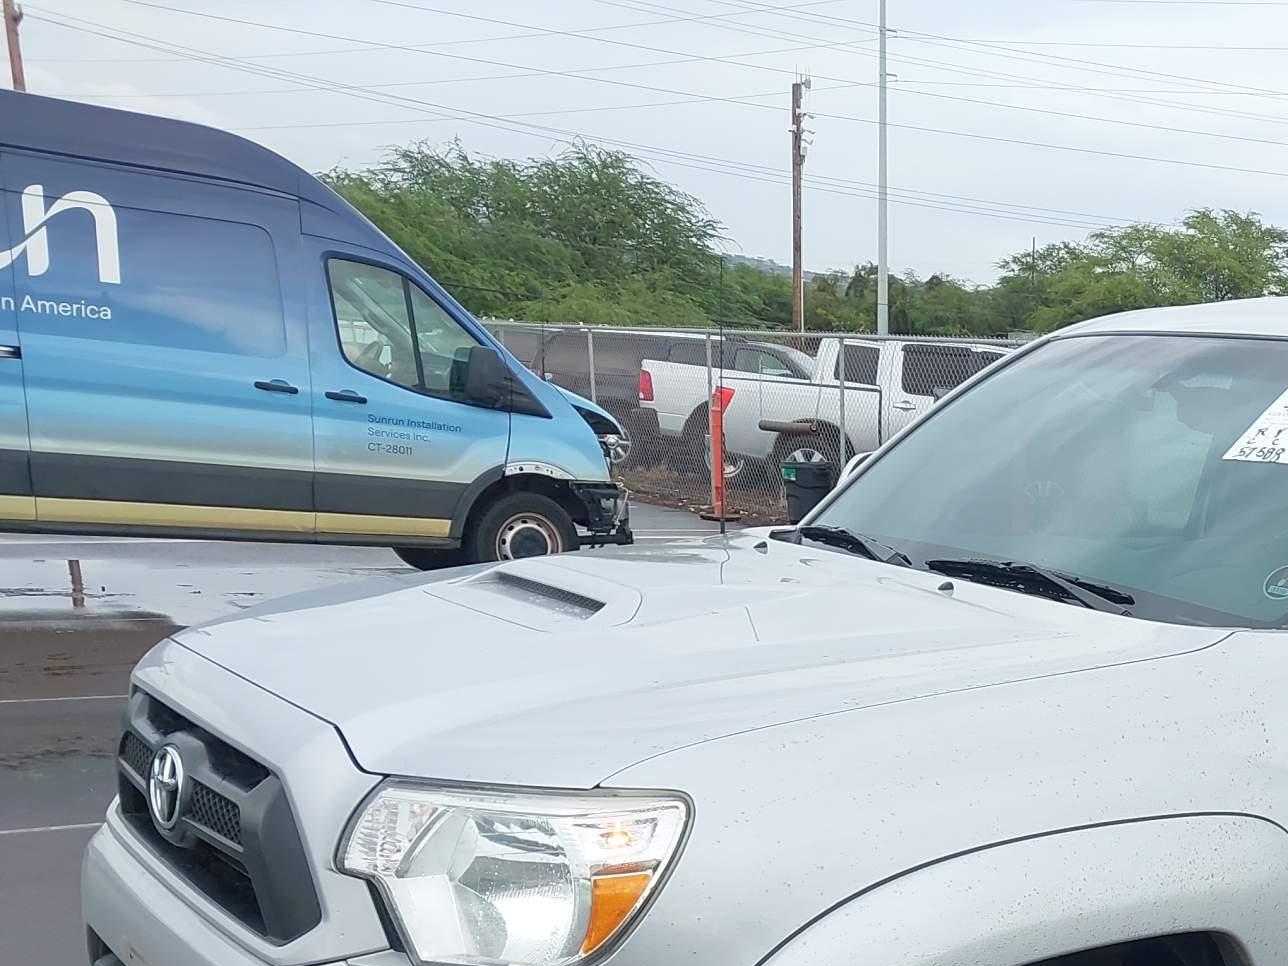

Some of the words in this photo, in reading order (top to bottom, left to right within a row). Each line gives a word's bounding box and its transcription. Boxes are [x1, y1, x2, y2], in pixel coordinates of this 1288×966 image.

[21, 295, 112, 320] America
[367, 413, 404, 426] Sunrun
[407, 418, 462, 433] Installation
[367, 426, 411, 440] Services
[413, 431, 431, 442] Inc.
[367, 442, 413, 456] CT-28011
